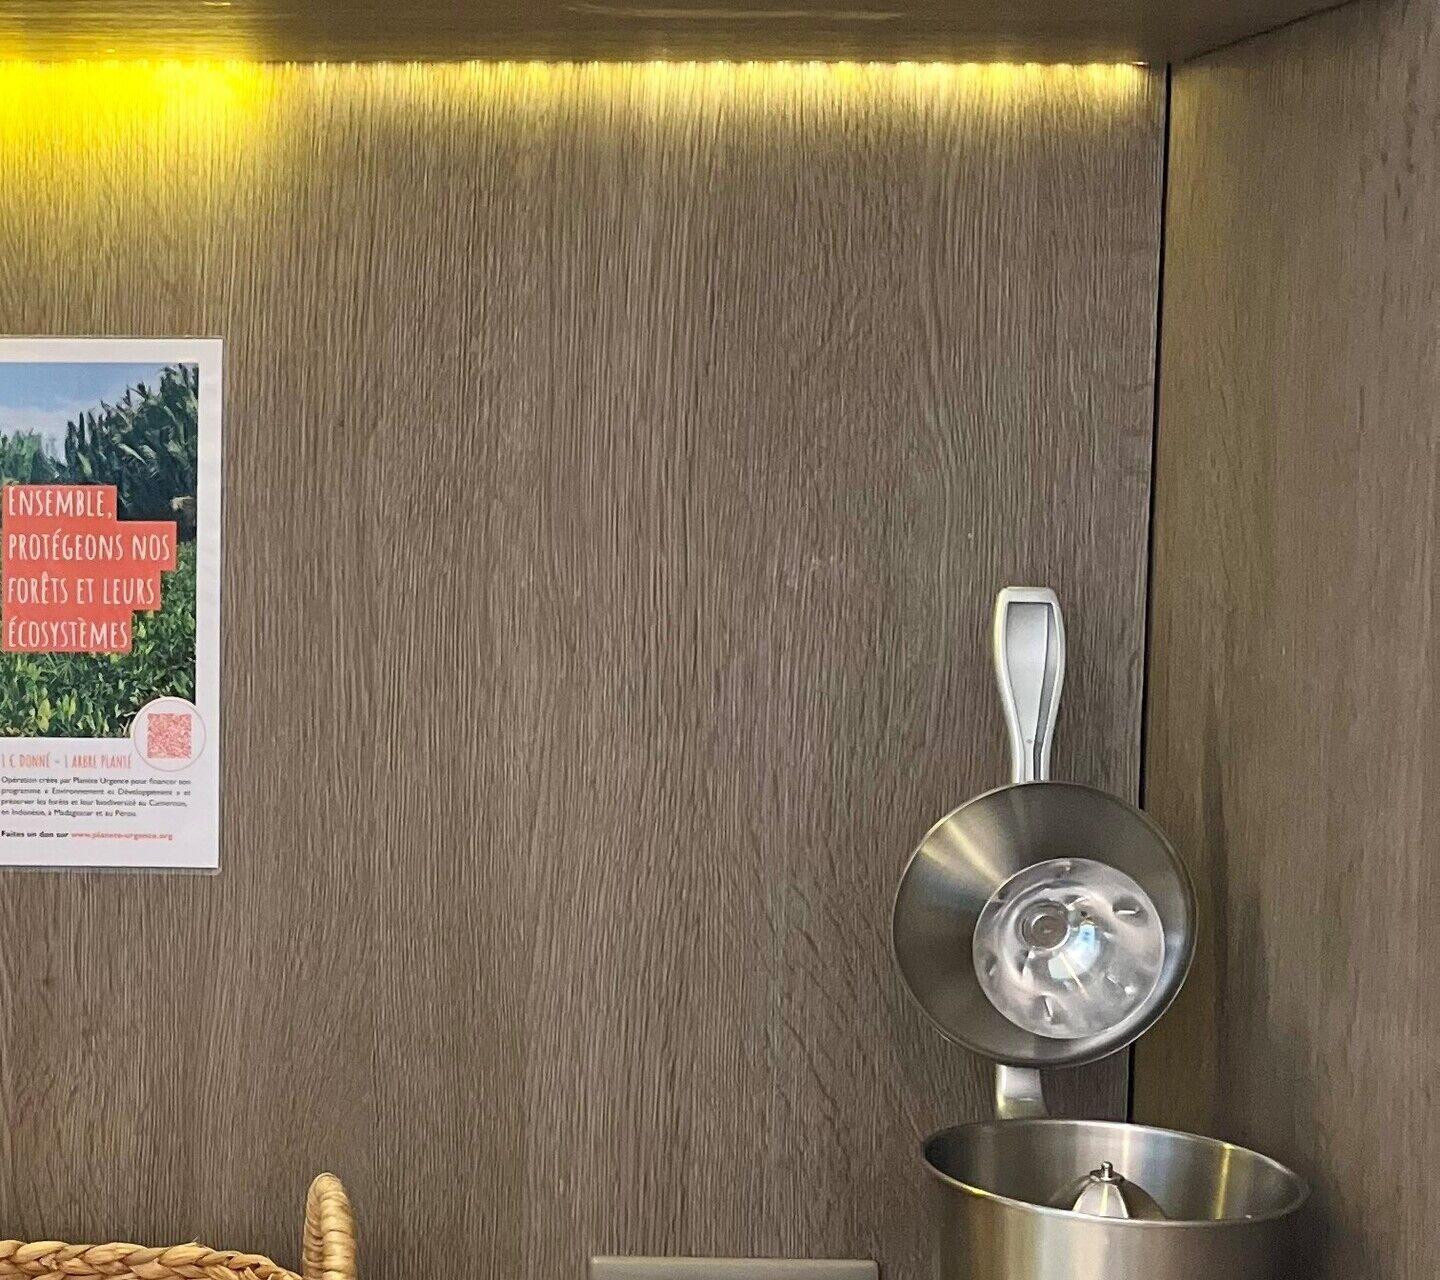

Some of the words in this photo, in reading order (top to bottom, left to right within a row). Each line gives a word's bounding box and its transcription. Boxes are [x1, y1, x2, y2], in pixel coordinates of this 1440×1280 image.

[8, 486, 112, 518] ENSEMBLE,
[8, 529, 124, 561] PROTÉGEONS
[132, 534, 170, 561] NOS
[8, 571, 69, 605] FORÊTS
[77, 578, 95, 605] ET
[103, 577, 155, 605] LEURS
[8, 616, 128, 649] ÉCOSYSTÈMES
[72, 754, 98, 768] ARBRE
[1, 830, 25, 838] Faites
[39, 830, 54, 838] don
